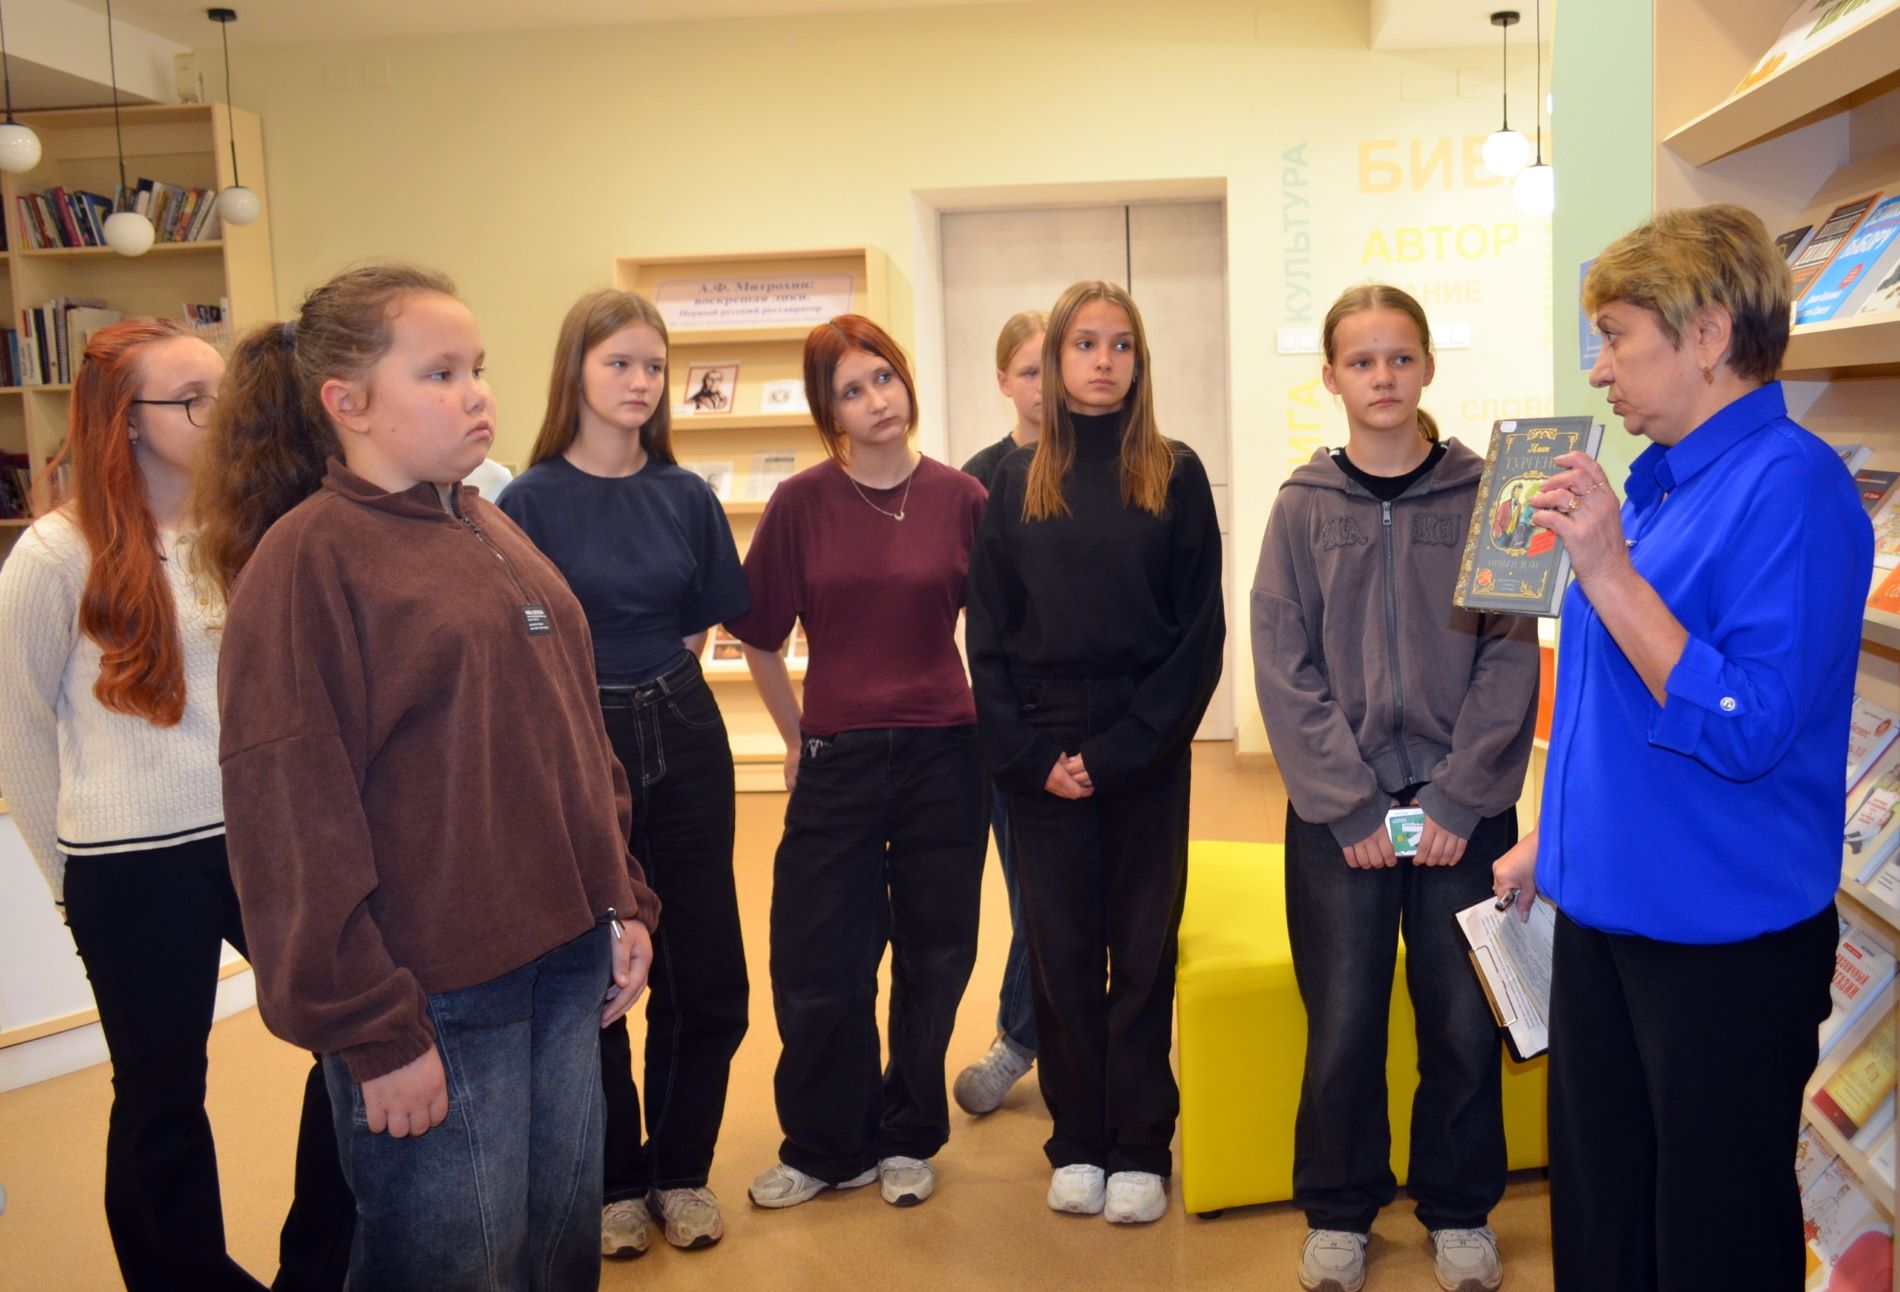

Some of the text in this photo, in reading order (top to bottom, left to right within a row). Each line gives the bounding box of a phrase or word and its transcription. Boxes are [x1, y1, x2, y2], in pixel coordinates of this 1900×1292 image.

[1359, 133, 1552, 194] БИБ
[1281, 142, 1312, 323] КУЛЬТУРА
[1361, 223, 1520, 264] АВТОР
[1288, 377, 1322, 464] ИГА
[1506, 455, 1558, 471] ТУРГЕН
